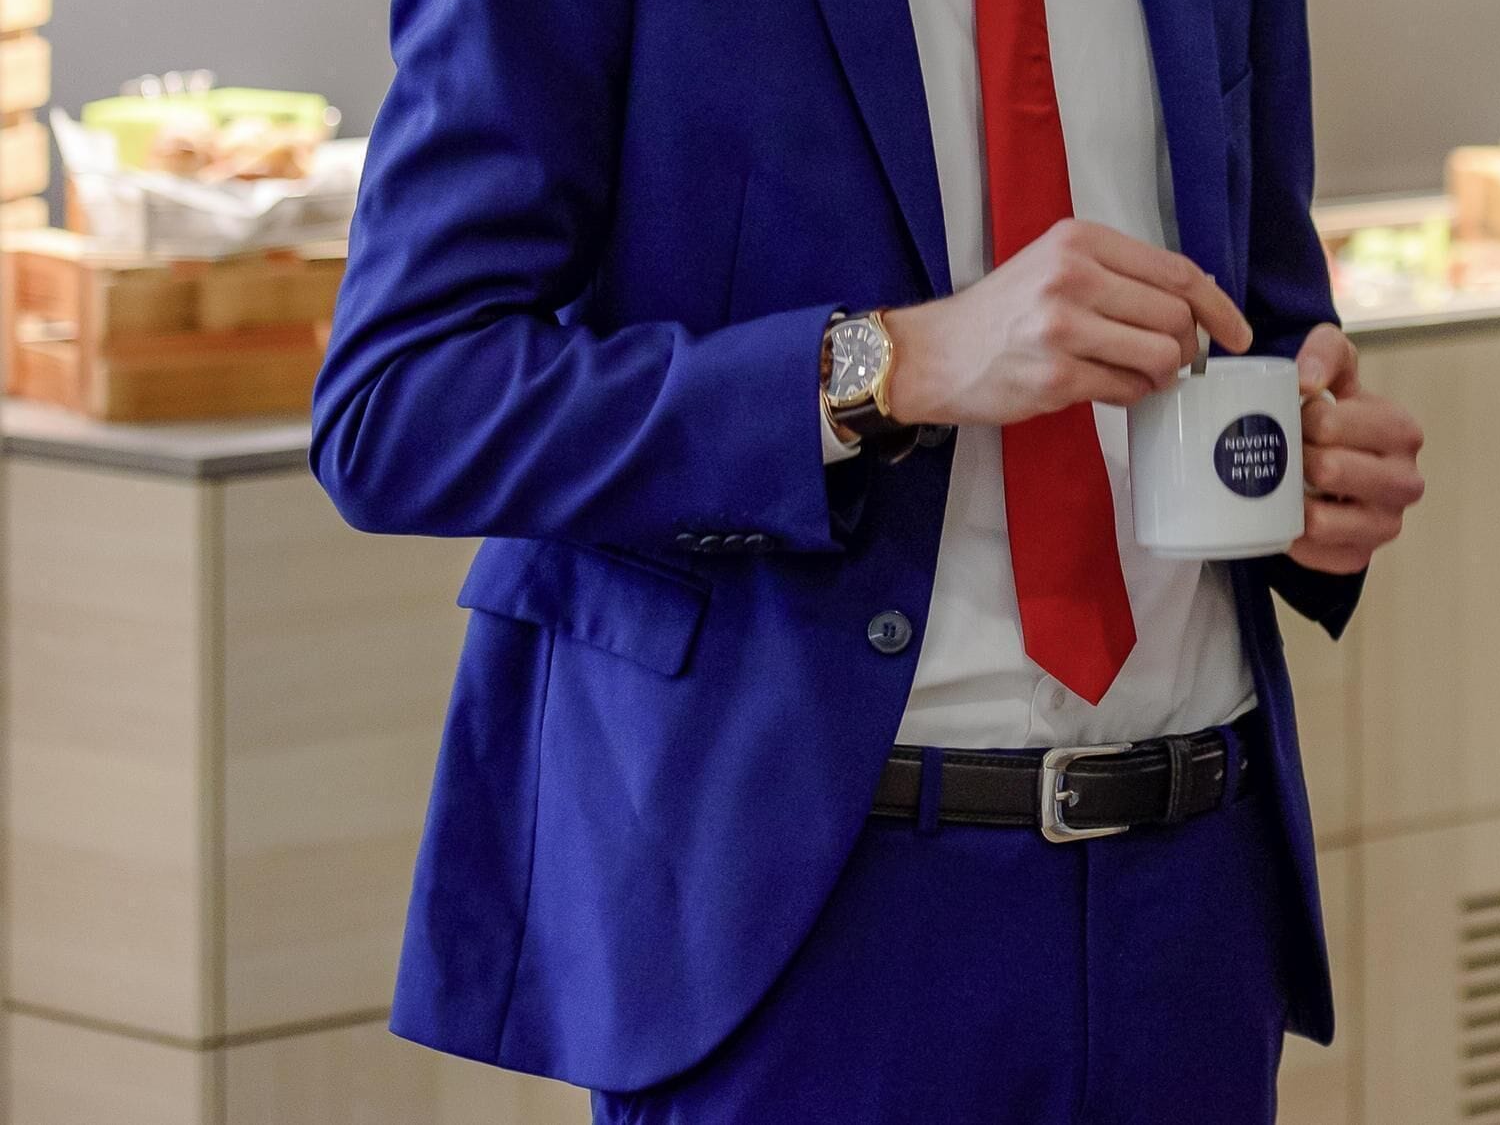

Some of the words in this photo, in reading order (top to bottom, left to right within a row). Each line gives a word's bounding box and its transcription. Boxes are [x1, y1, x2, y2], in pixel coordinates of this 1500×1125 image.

[1225, 433, 1280, 451] NOVOTEL
[1233, 449, 1275, 465] MAKES
[1231, 466, 1249, 481] MY
